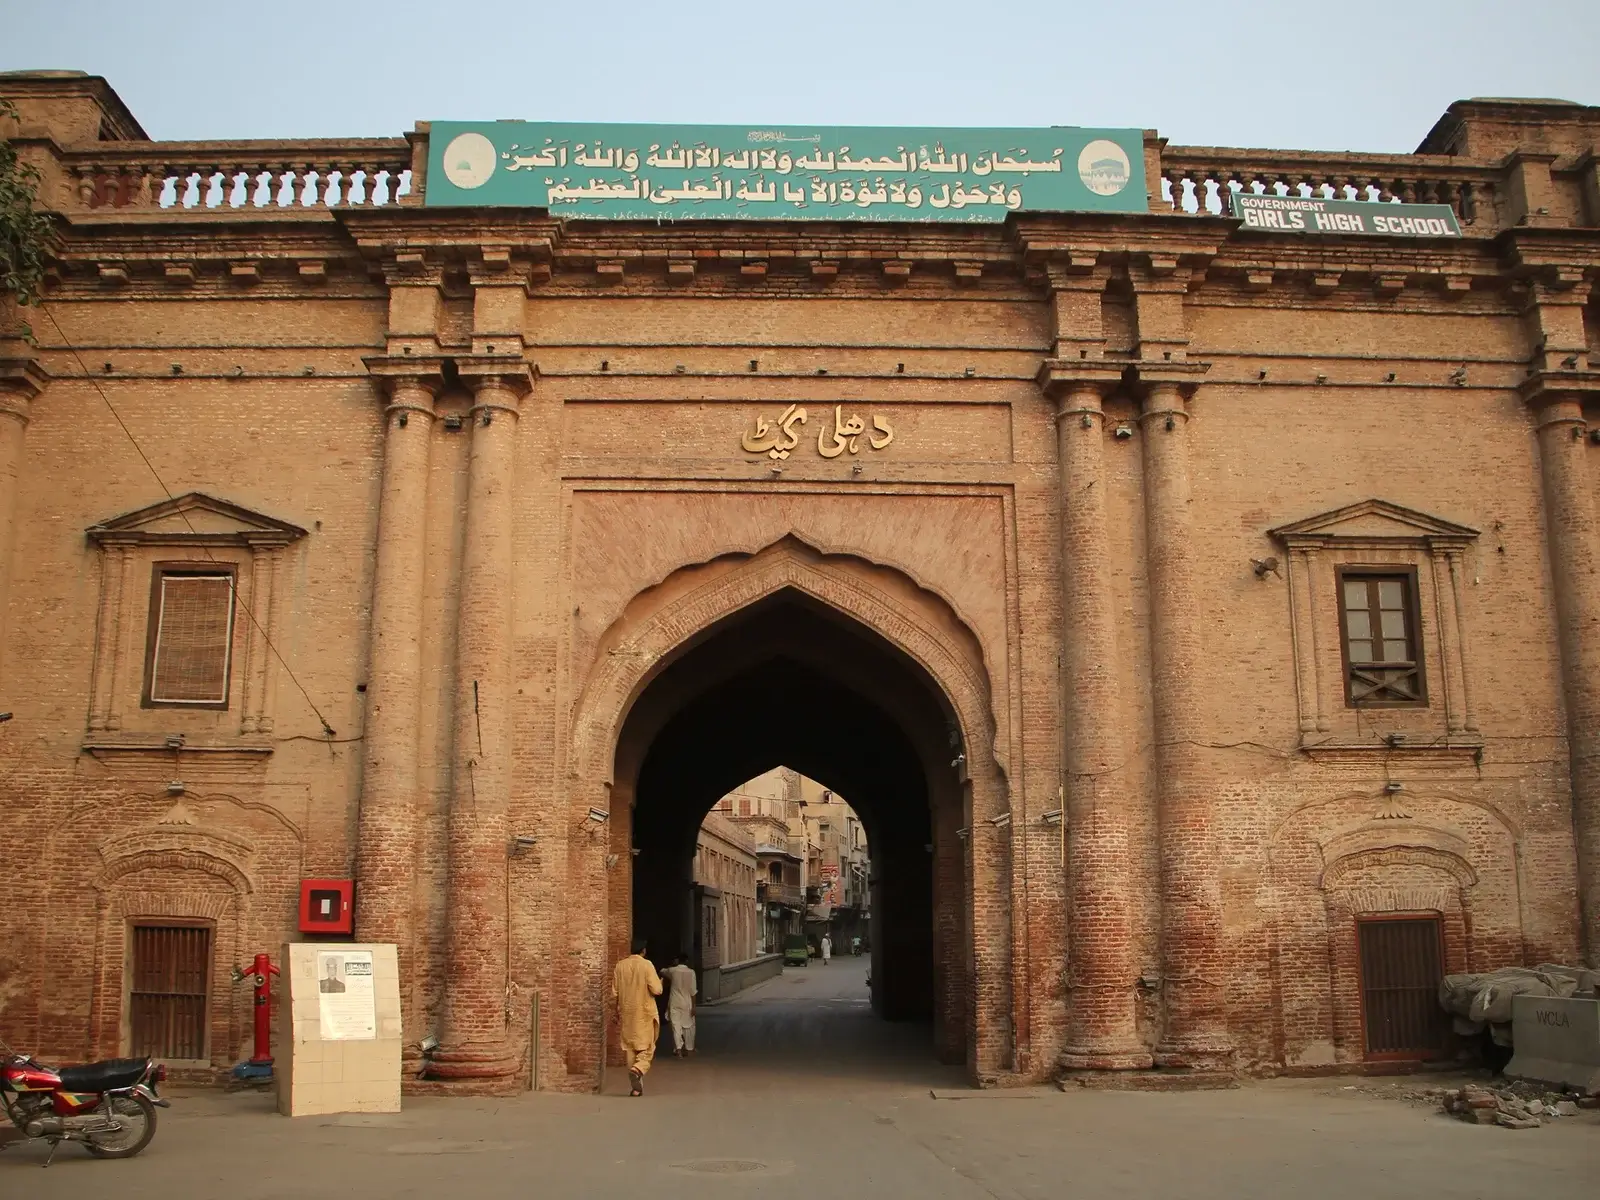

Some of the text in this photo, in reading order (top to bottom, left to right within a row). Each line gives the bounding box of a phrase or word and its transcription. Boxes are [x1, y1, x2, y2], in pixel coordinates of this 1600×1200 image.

[1241, 197, 1325, 212] GOVERNMENT
[1243, 208, 1456, 235] GIRLS HIGH SCHOOL
[1535, 1010, 1570, 1028] WCLA
